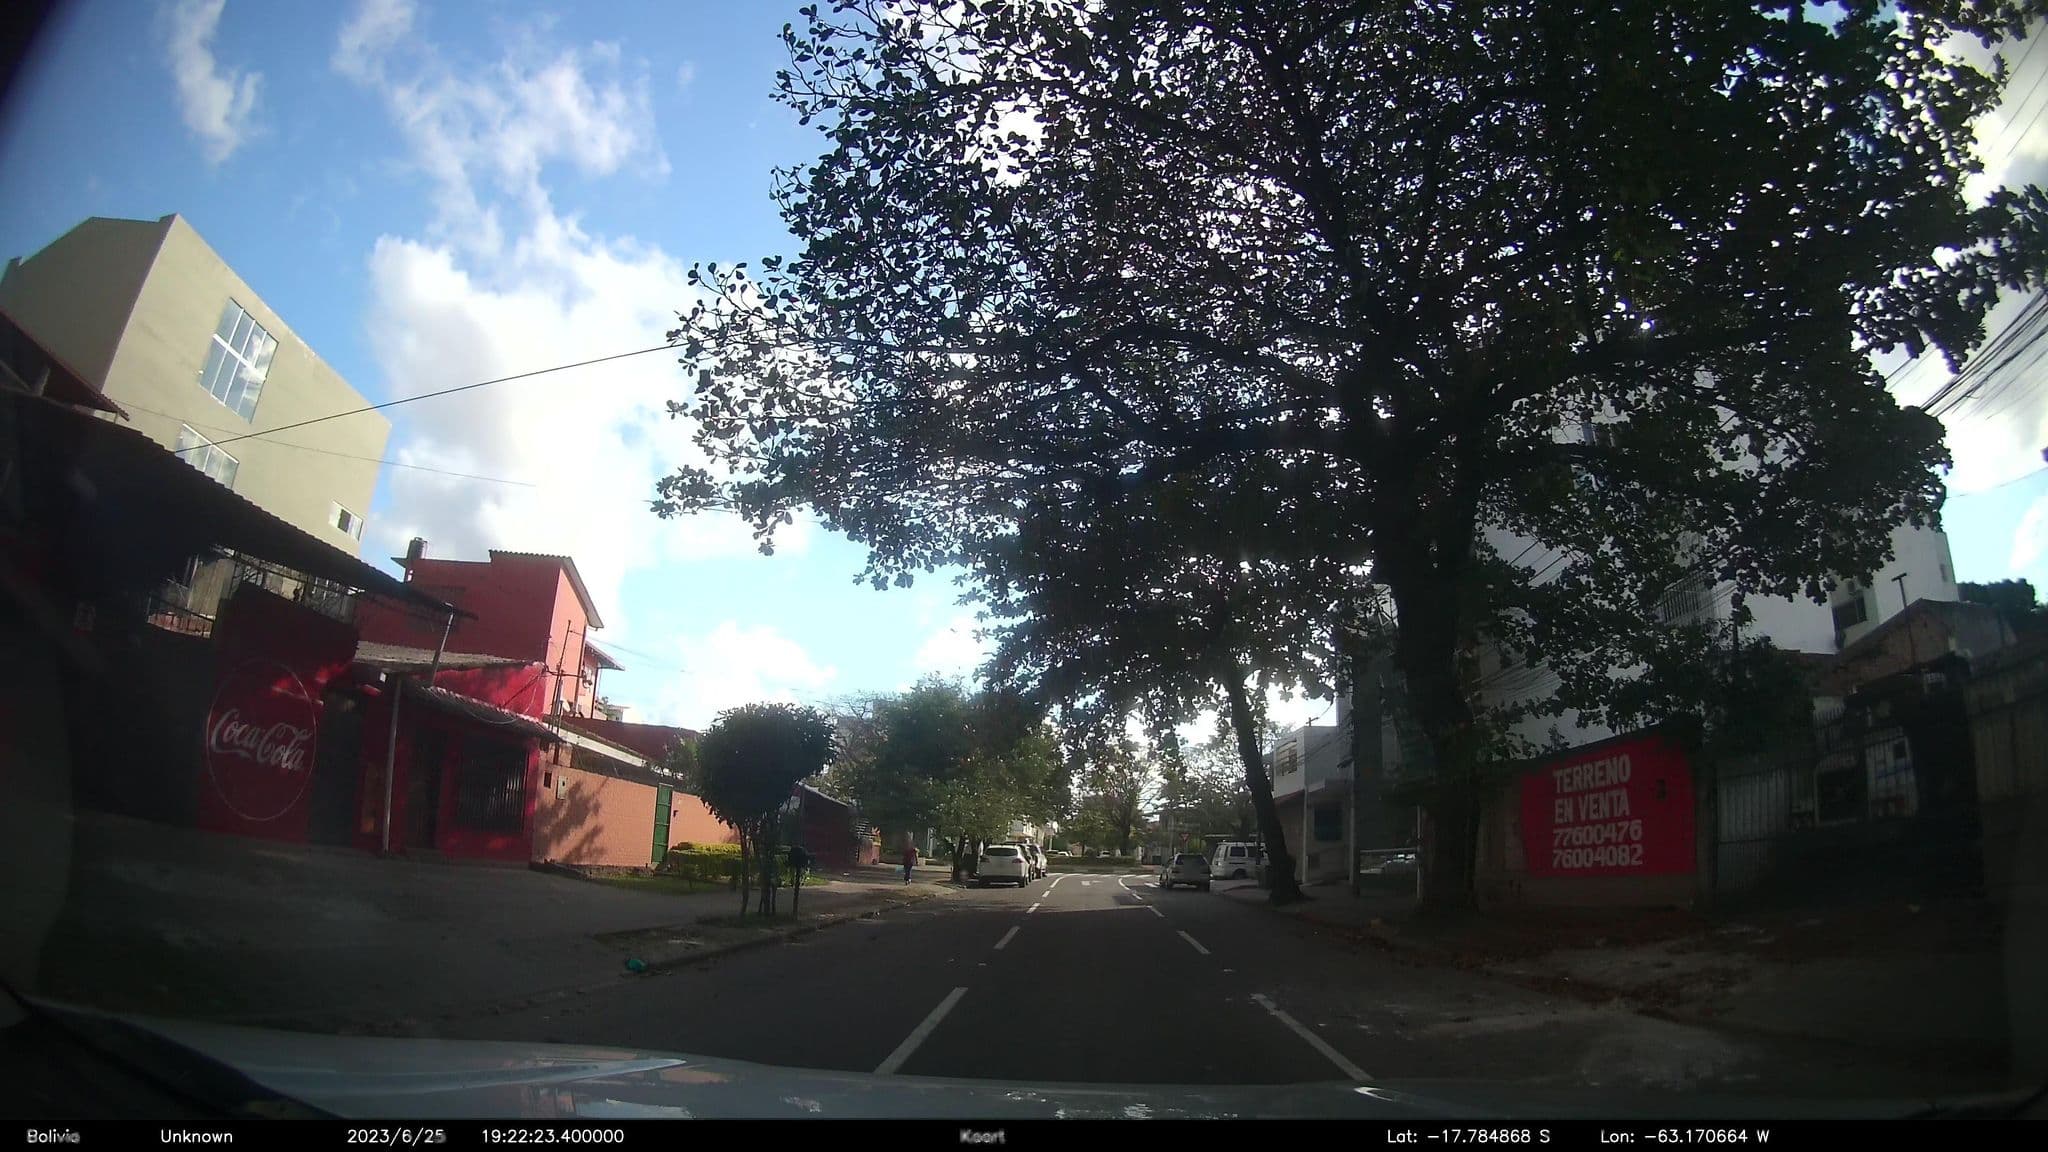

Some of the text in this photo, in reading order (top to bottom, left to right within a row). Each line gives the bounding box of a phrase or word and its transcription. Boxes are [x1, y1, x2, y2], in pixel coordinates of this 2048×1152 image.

[1553, 754, 1631, 793] TERRENO
[1555, 788, 1630, 824] EN VENTA
[1552, 820, 1642, 847] 77600476
[1552, 844, 1643, 868] 76004082
